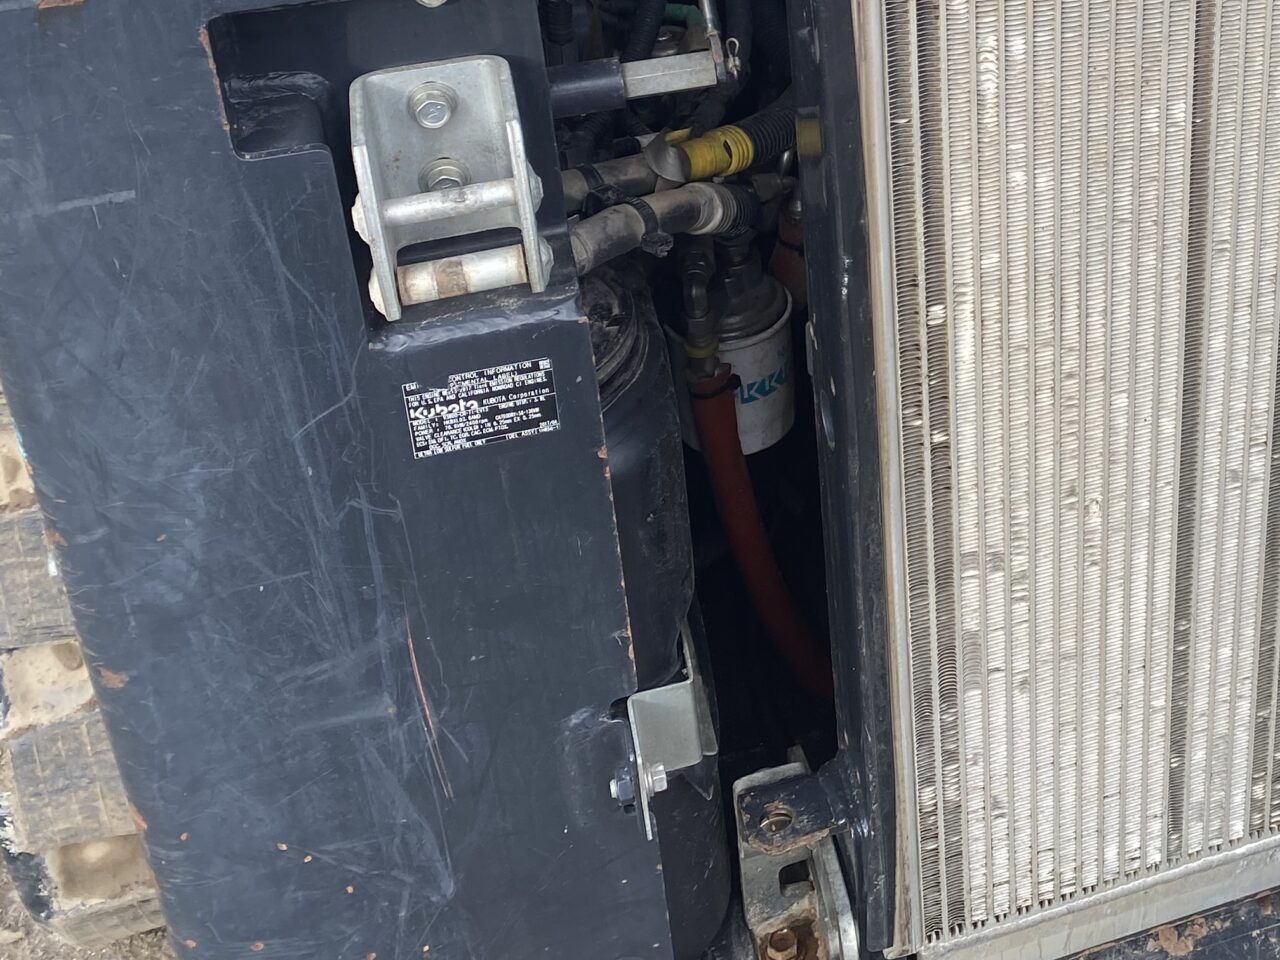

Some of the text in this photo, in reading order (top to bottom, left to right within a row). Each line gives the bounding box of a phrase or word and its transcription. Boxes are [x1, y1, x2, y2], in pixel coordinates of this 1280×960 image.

[483, 361, 531, 376] INFORMATION
[409, 386, 549, 421] Kubota KUBOTA Corporation
